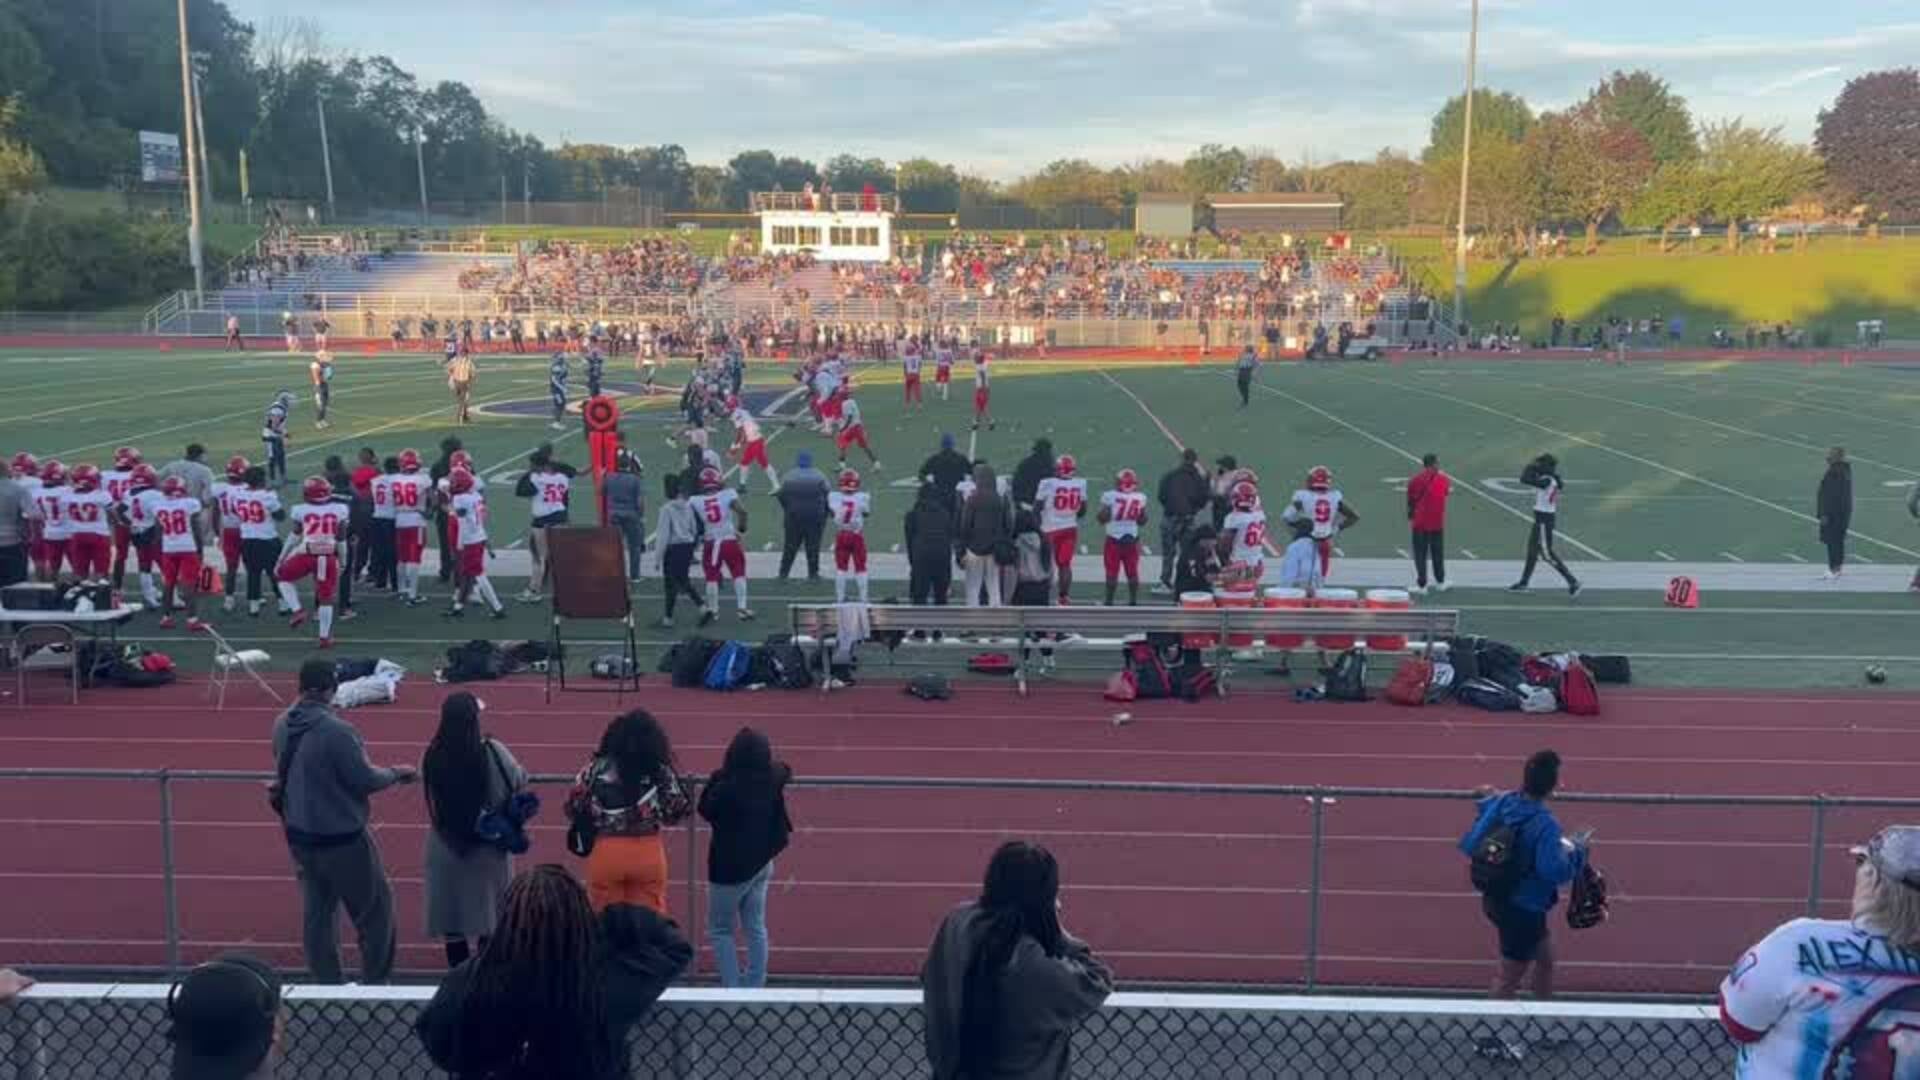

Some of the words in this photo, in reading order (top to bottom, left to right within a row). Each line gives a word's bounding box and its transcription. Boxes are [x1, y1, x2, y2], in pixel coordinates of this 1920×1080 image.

[236, 499, 266, 524] 59
[703, 498, 722, 523] 5
[841, 501, 856, 524] 7
[1314, 498, 1332, 523] 9
[1667, 576, 1692, 603] 30
